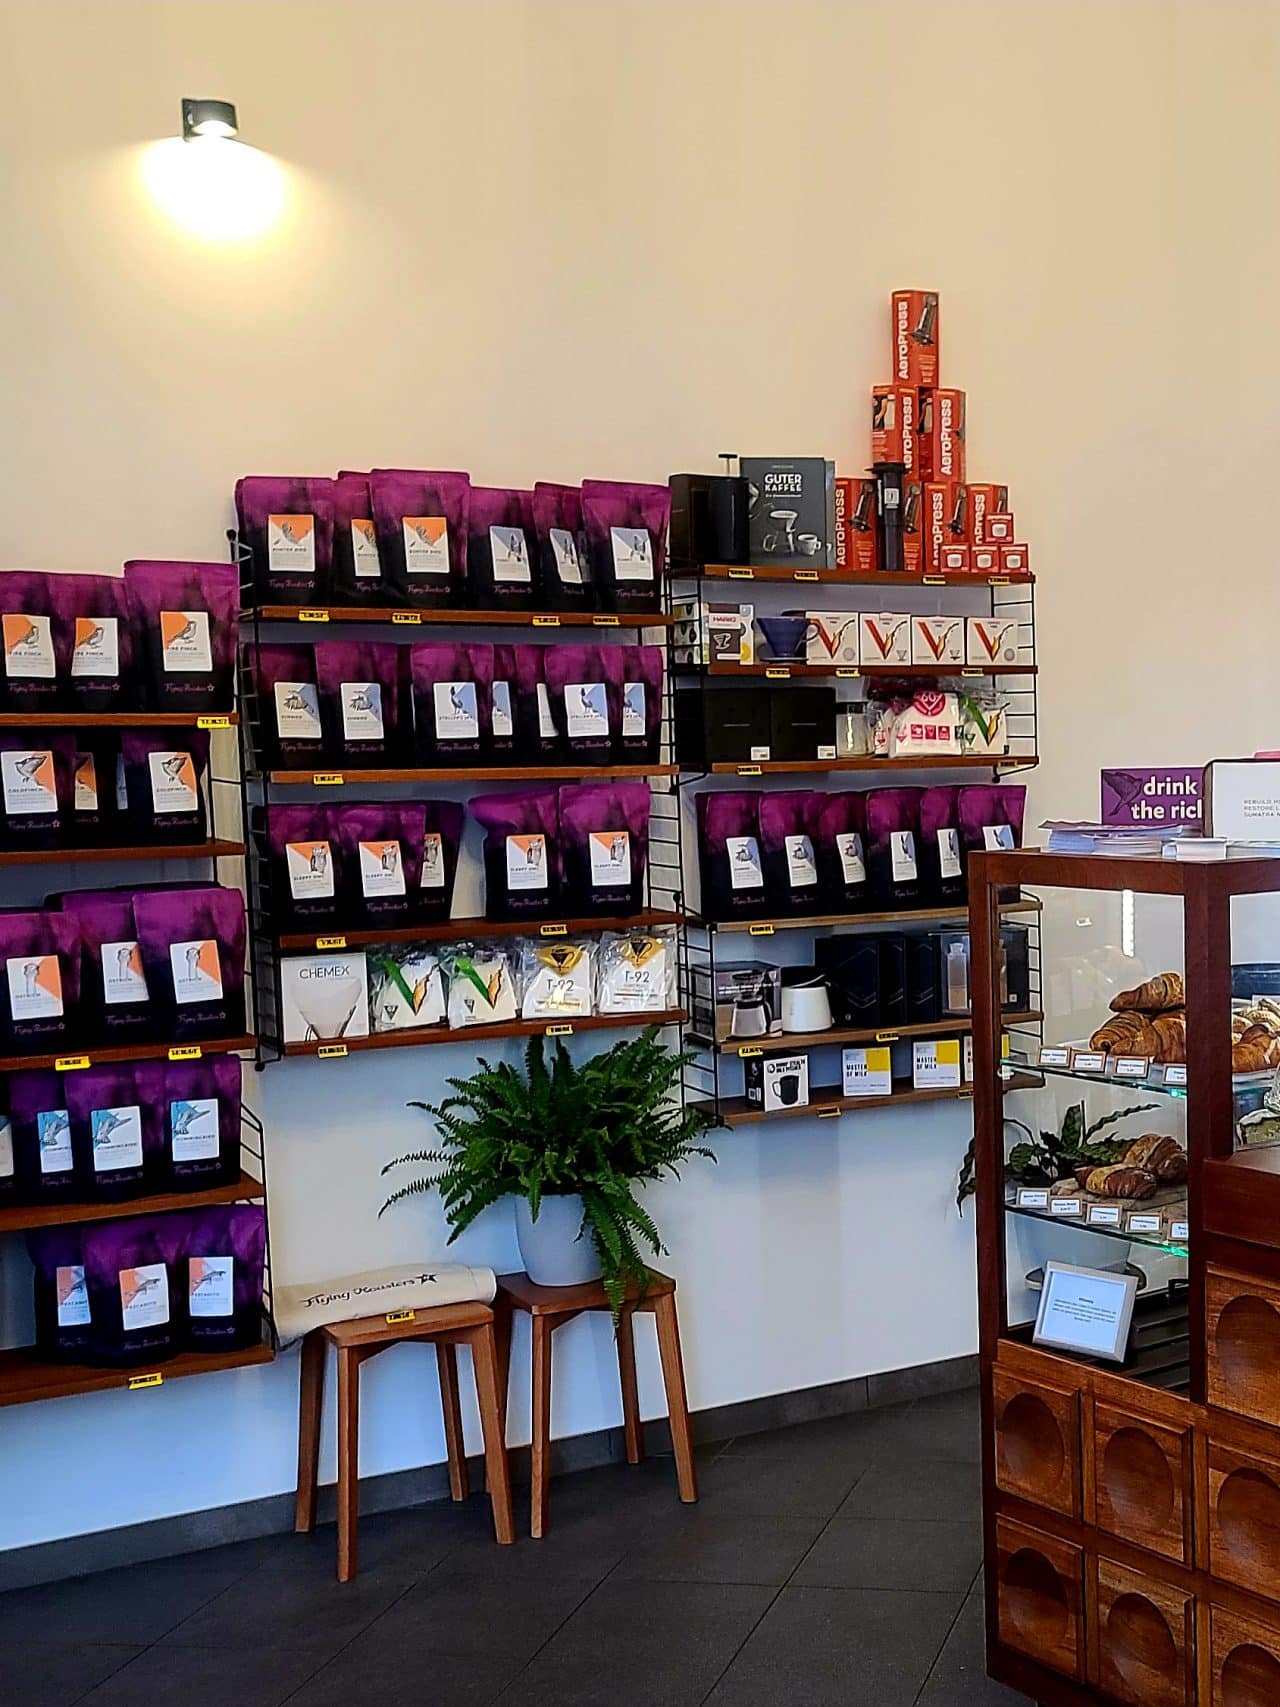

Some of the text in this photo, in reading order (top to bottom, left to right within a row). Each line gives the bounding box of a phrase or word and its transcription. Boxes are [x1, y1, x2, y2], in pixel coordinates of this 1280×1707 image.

[765, 474, 801, 483] GUTER
[1144, 775, 1197, 796] drink
[1131, 800, 1165, 819] the
[300, 965, 350, 979] CHEMEX
[625, 970, 650, 983] T-92
[916, 1056, 937, 1064] MASTER
[300, 1292, 350, 1308] Flying
